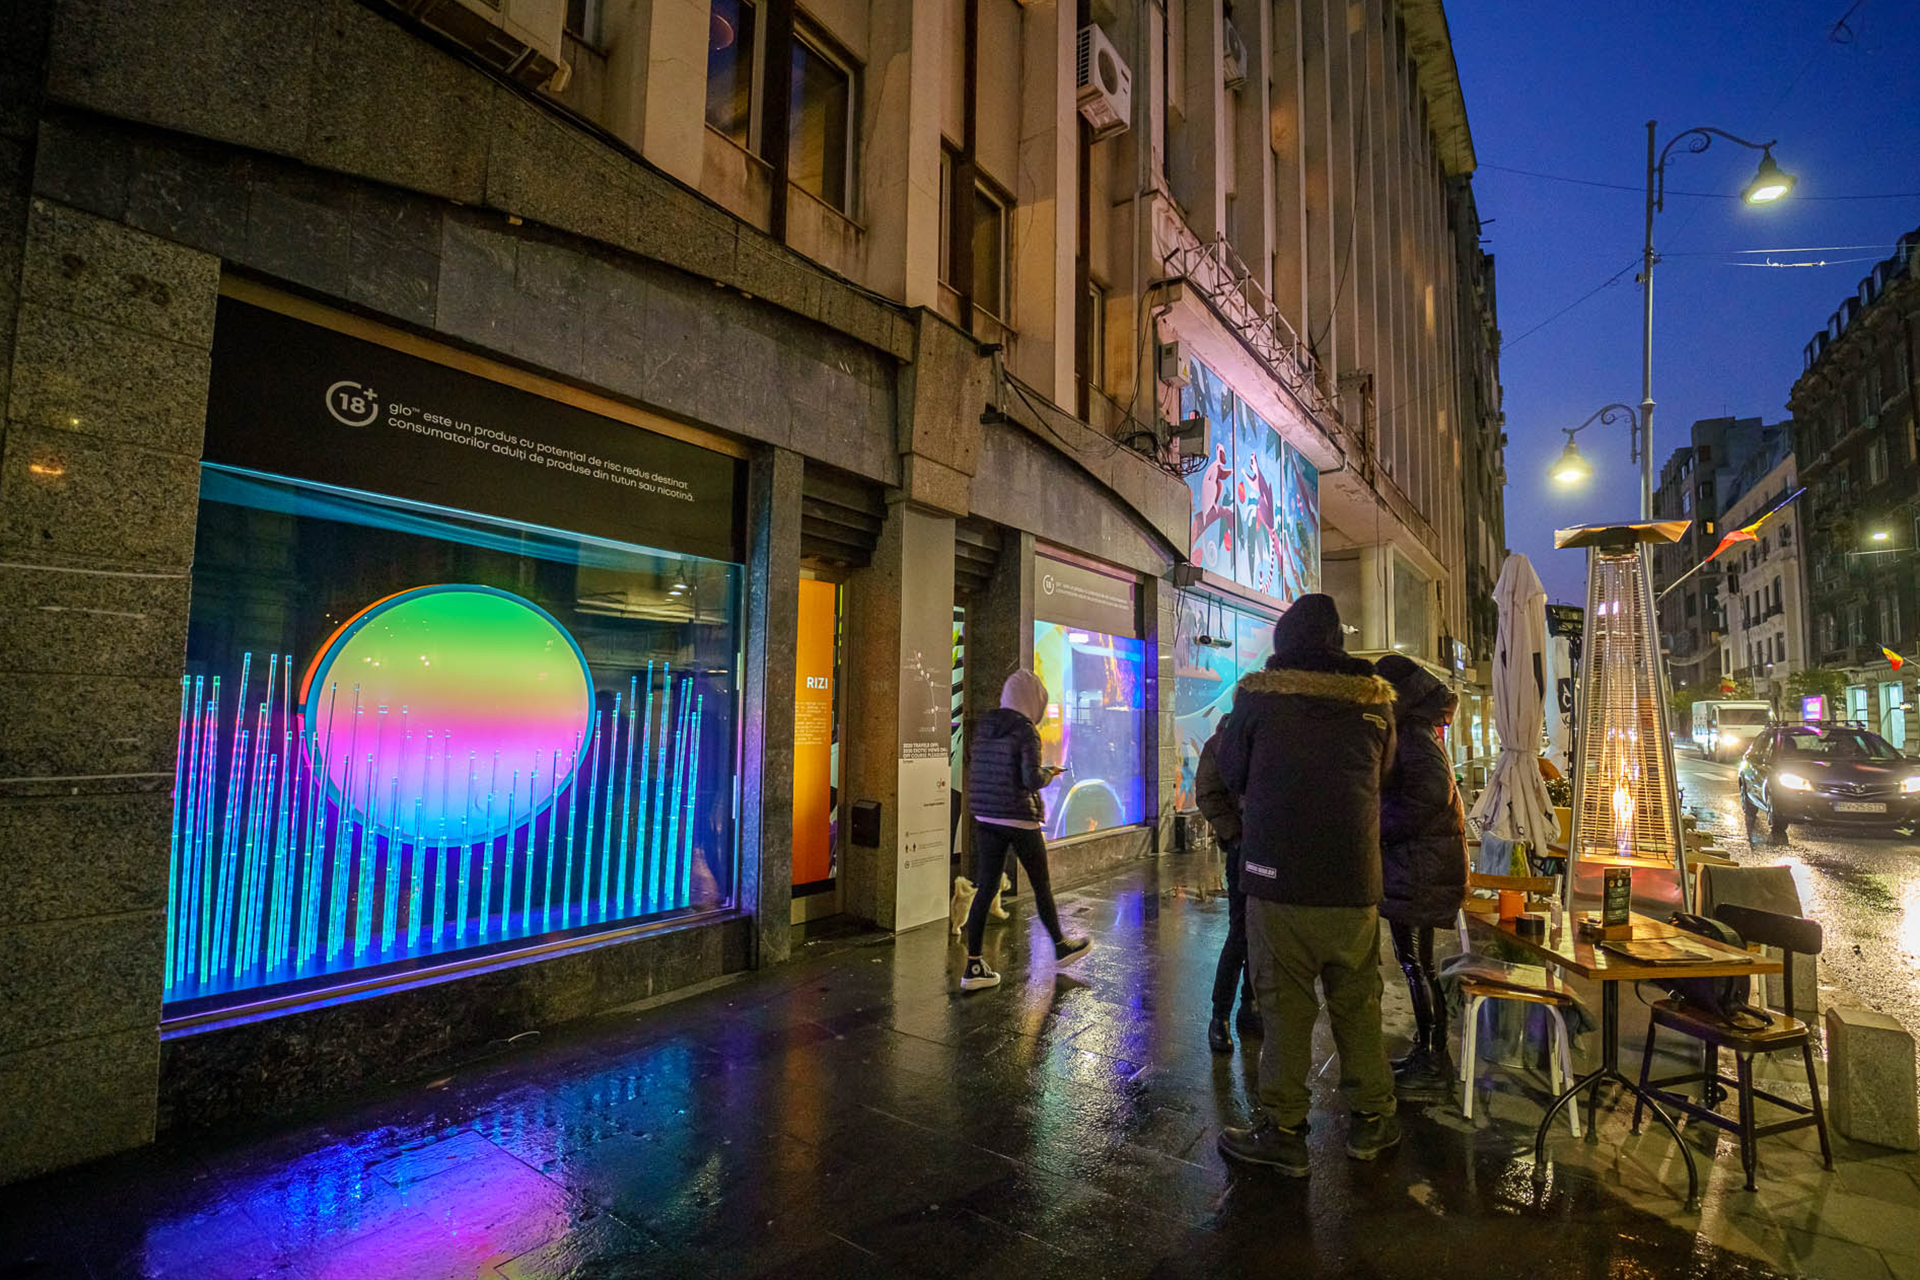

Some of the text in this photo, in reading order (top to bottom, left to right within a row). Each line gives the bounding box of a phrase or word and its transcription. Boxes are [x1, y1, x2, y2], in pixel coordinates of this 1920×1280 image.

[339, 388, 378, 414] 18+
[387, 417, 490, 450] consumatorilor
[528, 452, 545, 464] de
[546, 458, 591, 476] produse
[592, 469, 610, 481] din
[611, 473, 637, 488] tutun
[638, 481, 656, 493] sau
[423, 412, 452, 427] este
[454, 421, 472, 432] un
[473, 426, 518, 445] produs
[519, 438, 535, 449] cu
[587, 456, 602, 467] de
[603, 459, 622, 472] risc
[622, 466, 650, 480] redus
[651, 473, 689, 490] destinat
[806, 676, 828, 689] RIZI
